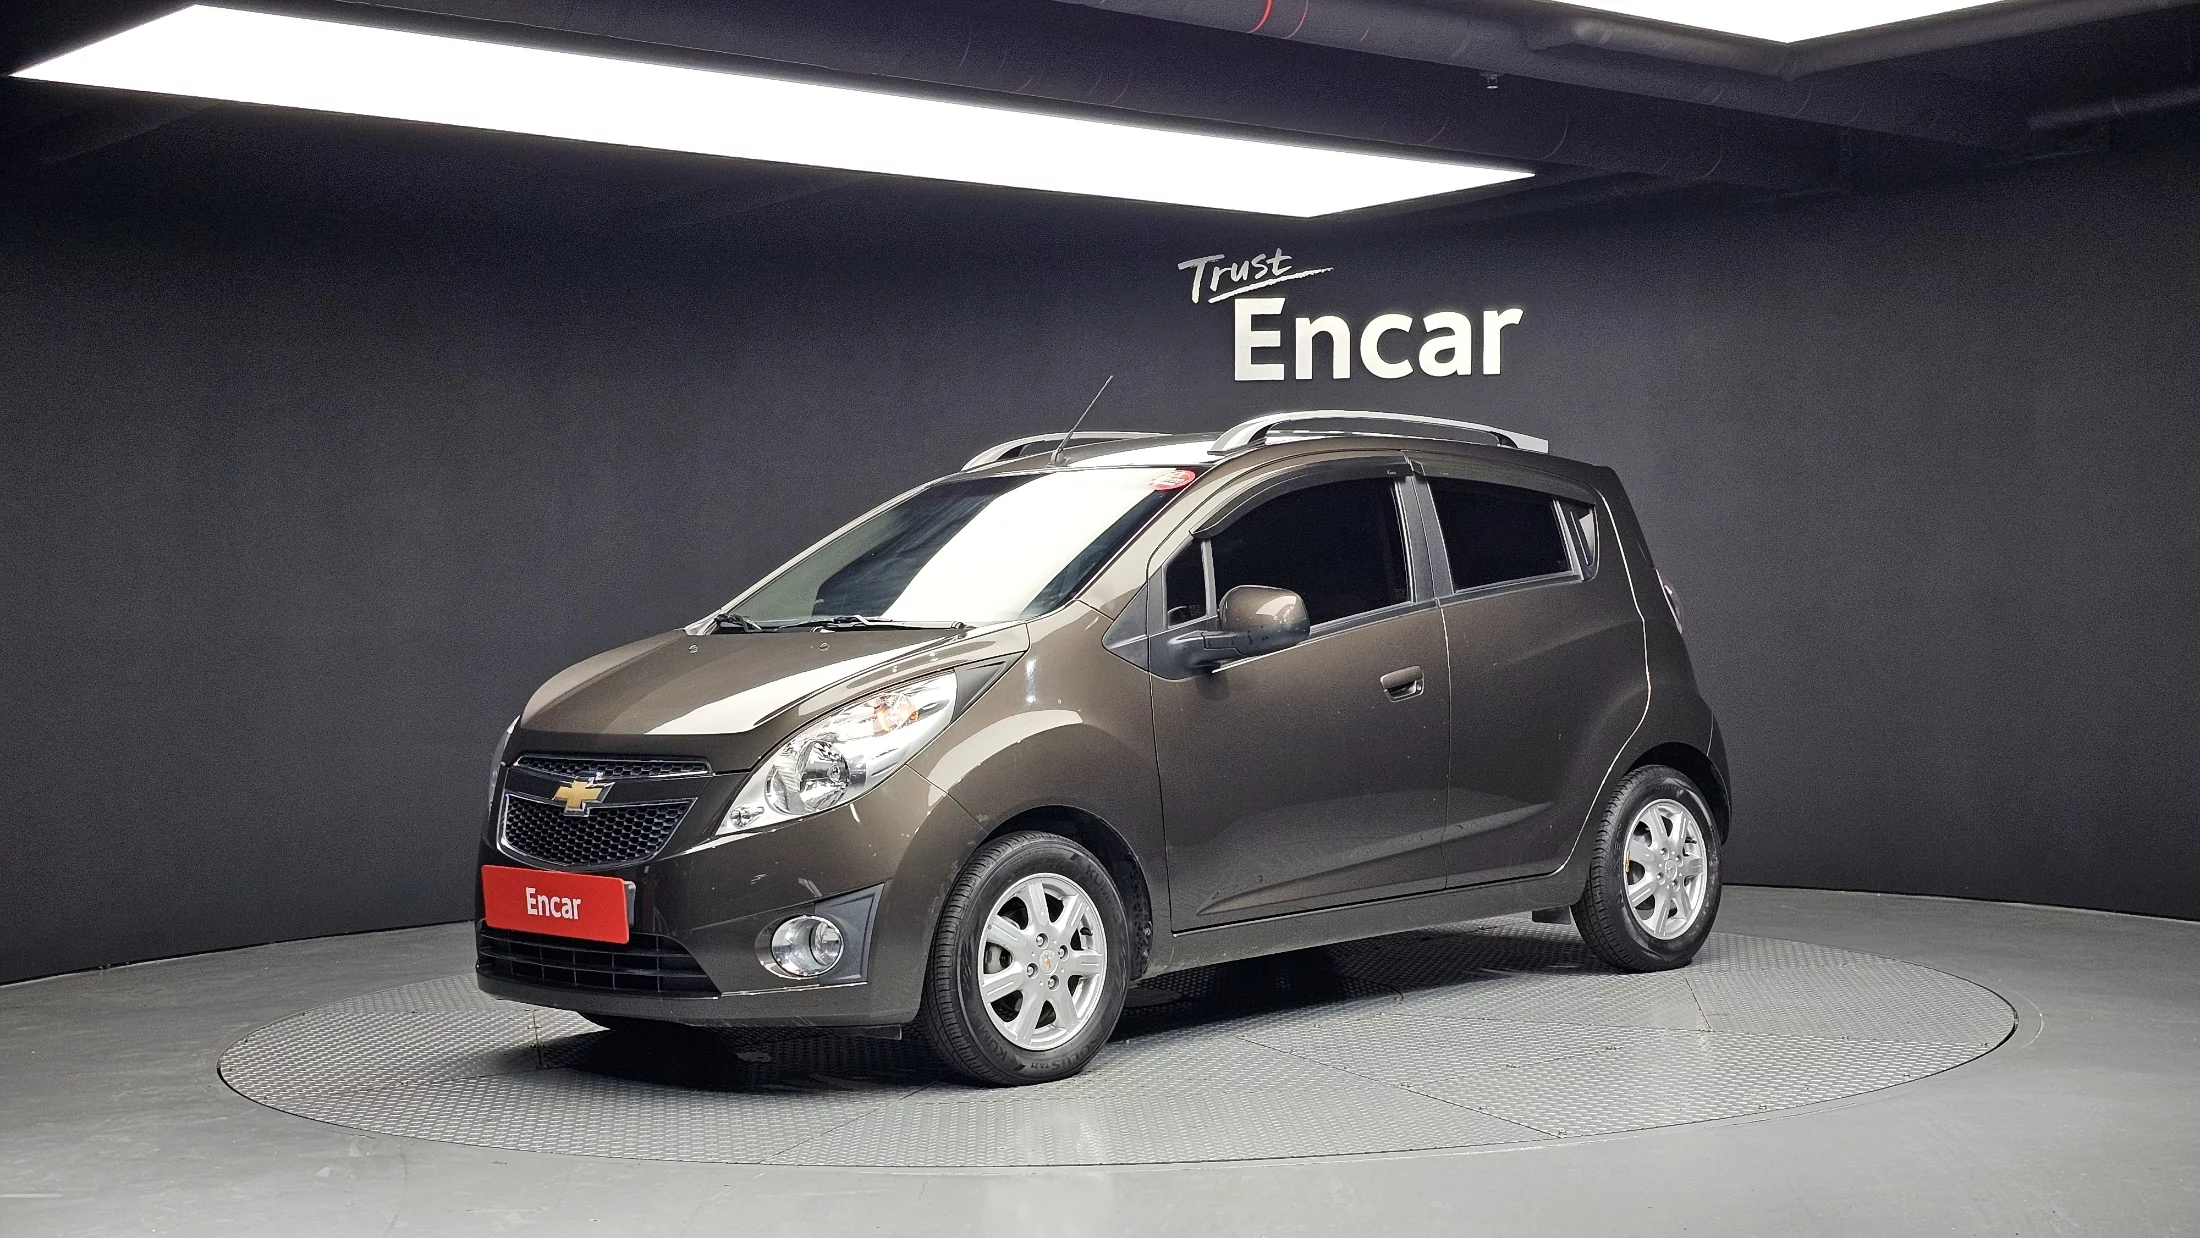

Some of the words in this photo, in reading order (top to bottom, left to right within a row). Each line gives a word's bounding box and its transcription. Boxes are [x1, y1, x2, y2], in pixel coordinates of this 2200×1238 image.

[1177, 248, 1293, 303] Trust
[1234, 297, 1525, 381] Encar
[525, 887, 582, 920] Encar
